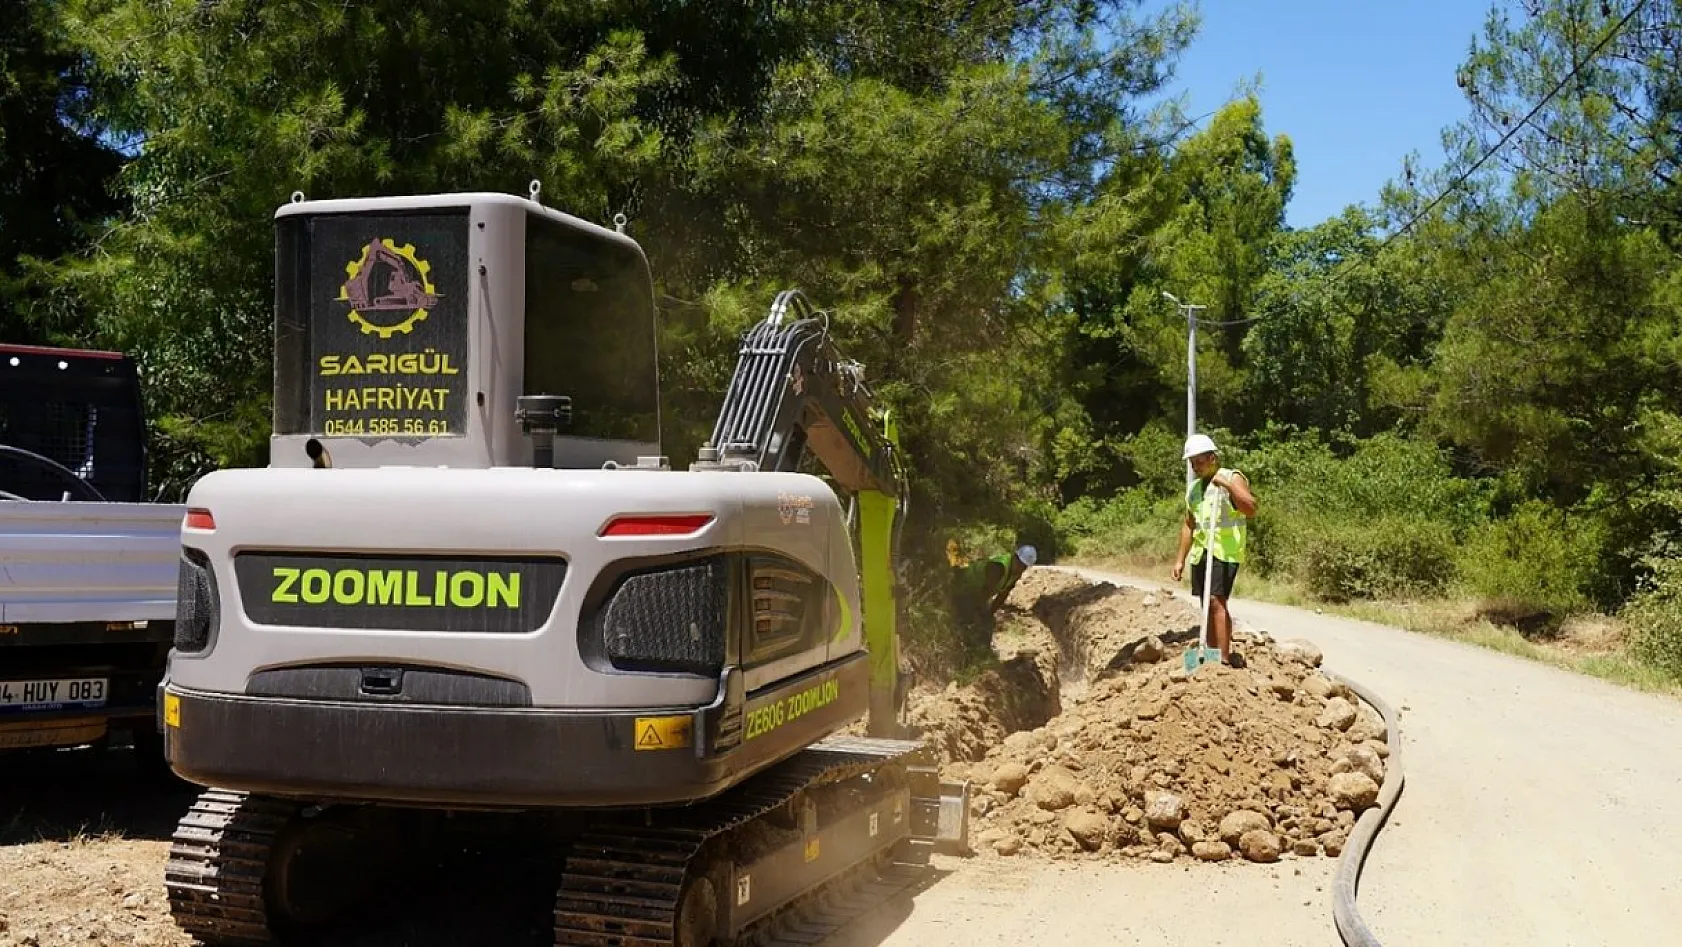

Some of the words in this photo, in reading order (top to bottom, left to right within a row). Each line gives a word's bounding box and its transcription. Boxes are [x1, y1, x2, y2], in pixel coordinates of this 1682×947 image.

[320, 348, 459, 375] SARIGÜL
[325, 383, 450, 411] HAFRİYAT
[325, 419, 364, 436] 0544
[369, 418, 399, 435] 585
[404, 418, 424, 435] 56
[429, 419, 448, 435] 61
[271, 568, 521, 608] ZOOMLION
[0, 683, 13, 703] 4
[23, 682, 59, 702] HUY
[69, 681, 103, 700] 083
[787, 678, 838, 720] ZOOMLION
